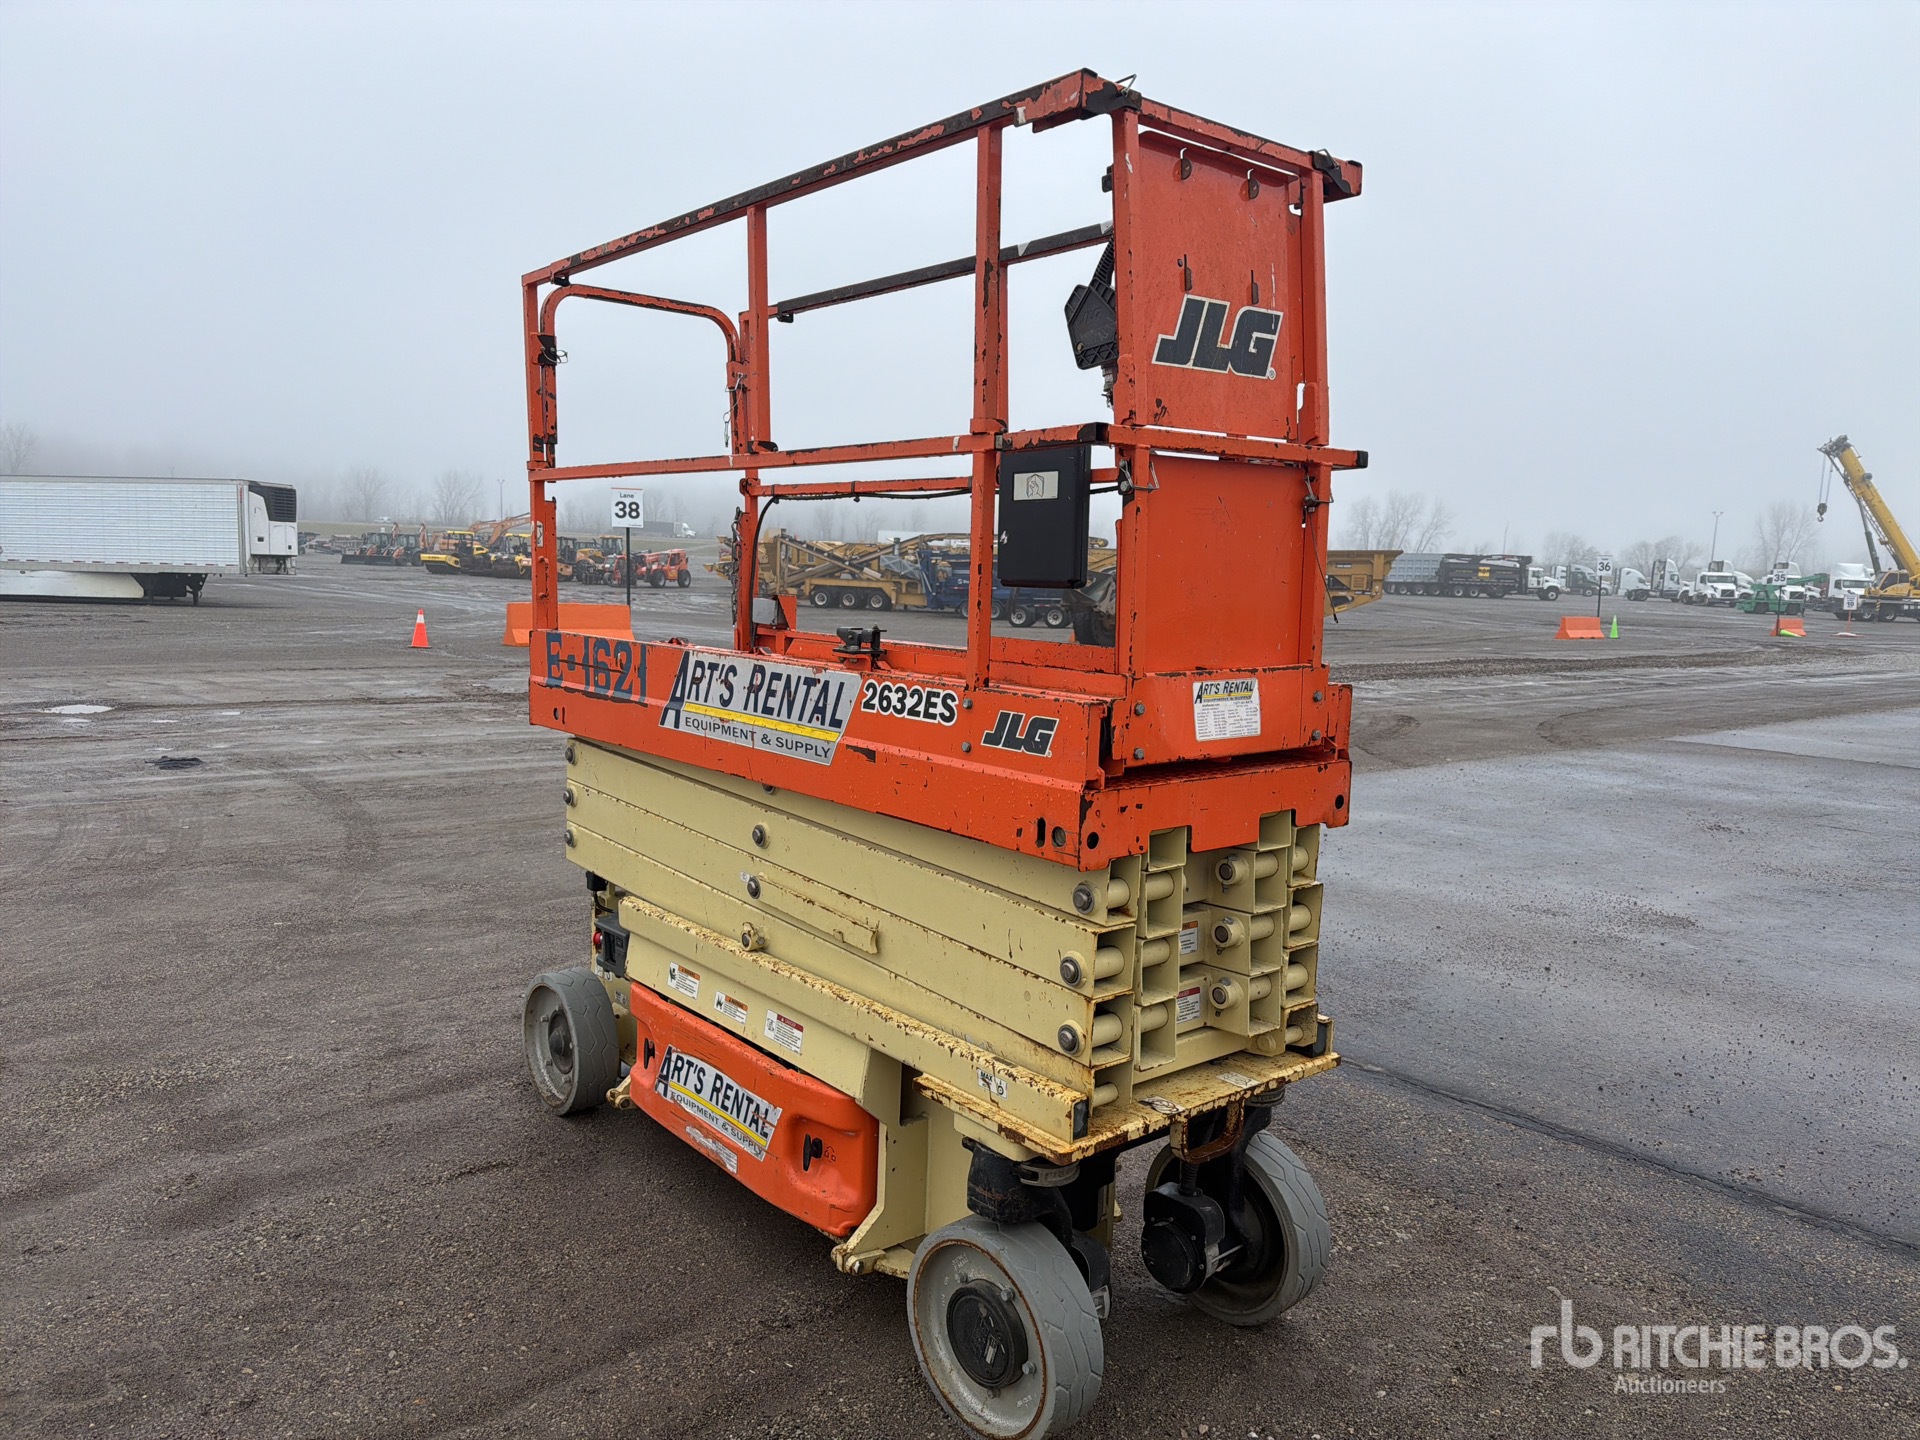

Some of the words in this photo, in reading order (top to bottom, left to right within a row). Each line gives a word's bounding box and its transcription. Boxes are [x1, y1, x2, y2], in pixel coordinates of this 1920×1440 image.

[1152, 294, 1283, 379] JLG
[614, 500, 640, 520] 38
[1598, 561, 1611, 572] 36
[1774, 573, 1786, 582] 35
[546, 632, 647, 703] E-1621
[660, 651, 739, 729] ART'S
[743, 663, 846, 729] RENTAL
[862, 681, 958, 724] 2632ES
[1195, 682, 1221, 704] ART'S
[1223, 680, 1254, 694] RENTAL
[684, 716, 757, 743] EQUIPMENT
[761, 733, 772, 745] &
[775, 735, 831, 760] SUPPLY
[981, 710, 1060, 757] JLG
[654, 1046, 706, 1098] ART'S
[709, 1072, 770, 1140] RENTAL
[670, 1091, 720, 1125] EQUIPMENT
[721, 1122, 729, 1133] &
[730, 1127, 763, 1157] SUPPLY
